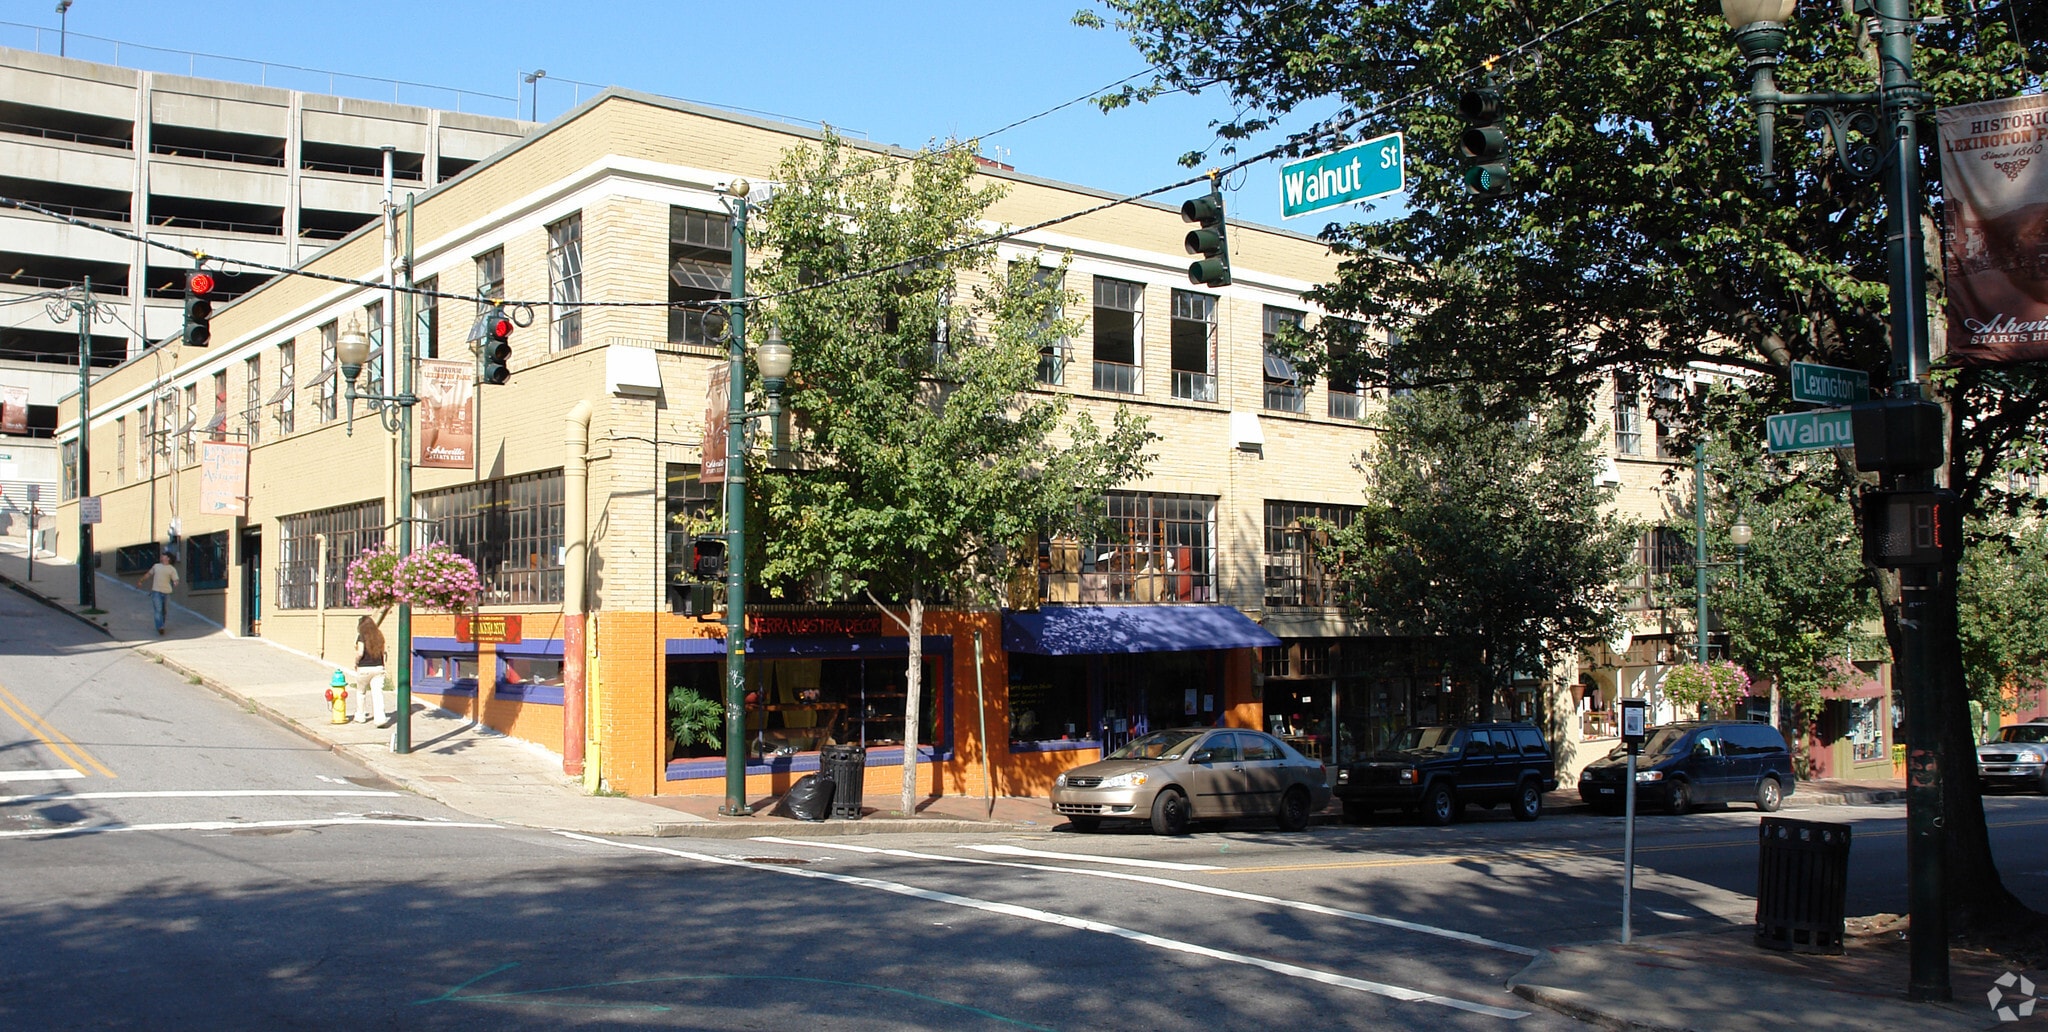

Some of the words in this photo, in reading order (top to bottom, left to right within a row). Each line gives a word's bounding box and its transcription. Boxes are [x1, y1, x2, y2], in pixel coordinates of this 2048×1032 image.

[1946, 129, 2032, 153] LEXINGTON
[1981, 150, 2010, 161] Since
[2013, 144, 2043, 157] 1860
[1284, 156, 1362, 207] Walnut
[1380, 145, 1398, 169] St
[1970, 333, 2028, 345] STARTS
[1794, 366, 1800, 380] N
[1802, 367, 1854, 400] Lexington
[1770, 414, 1851, 447] Walnu
[753, 617, 790, 634] TERRA
[791, 617, 843, 634] NOSTRA
[845, 617, 881, 634] DECOR
